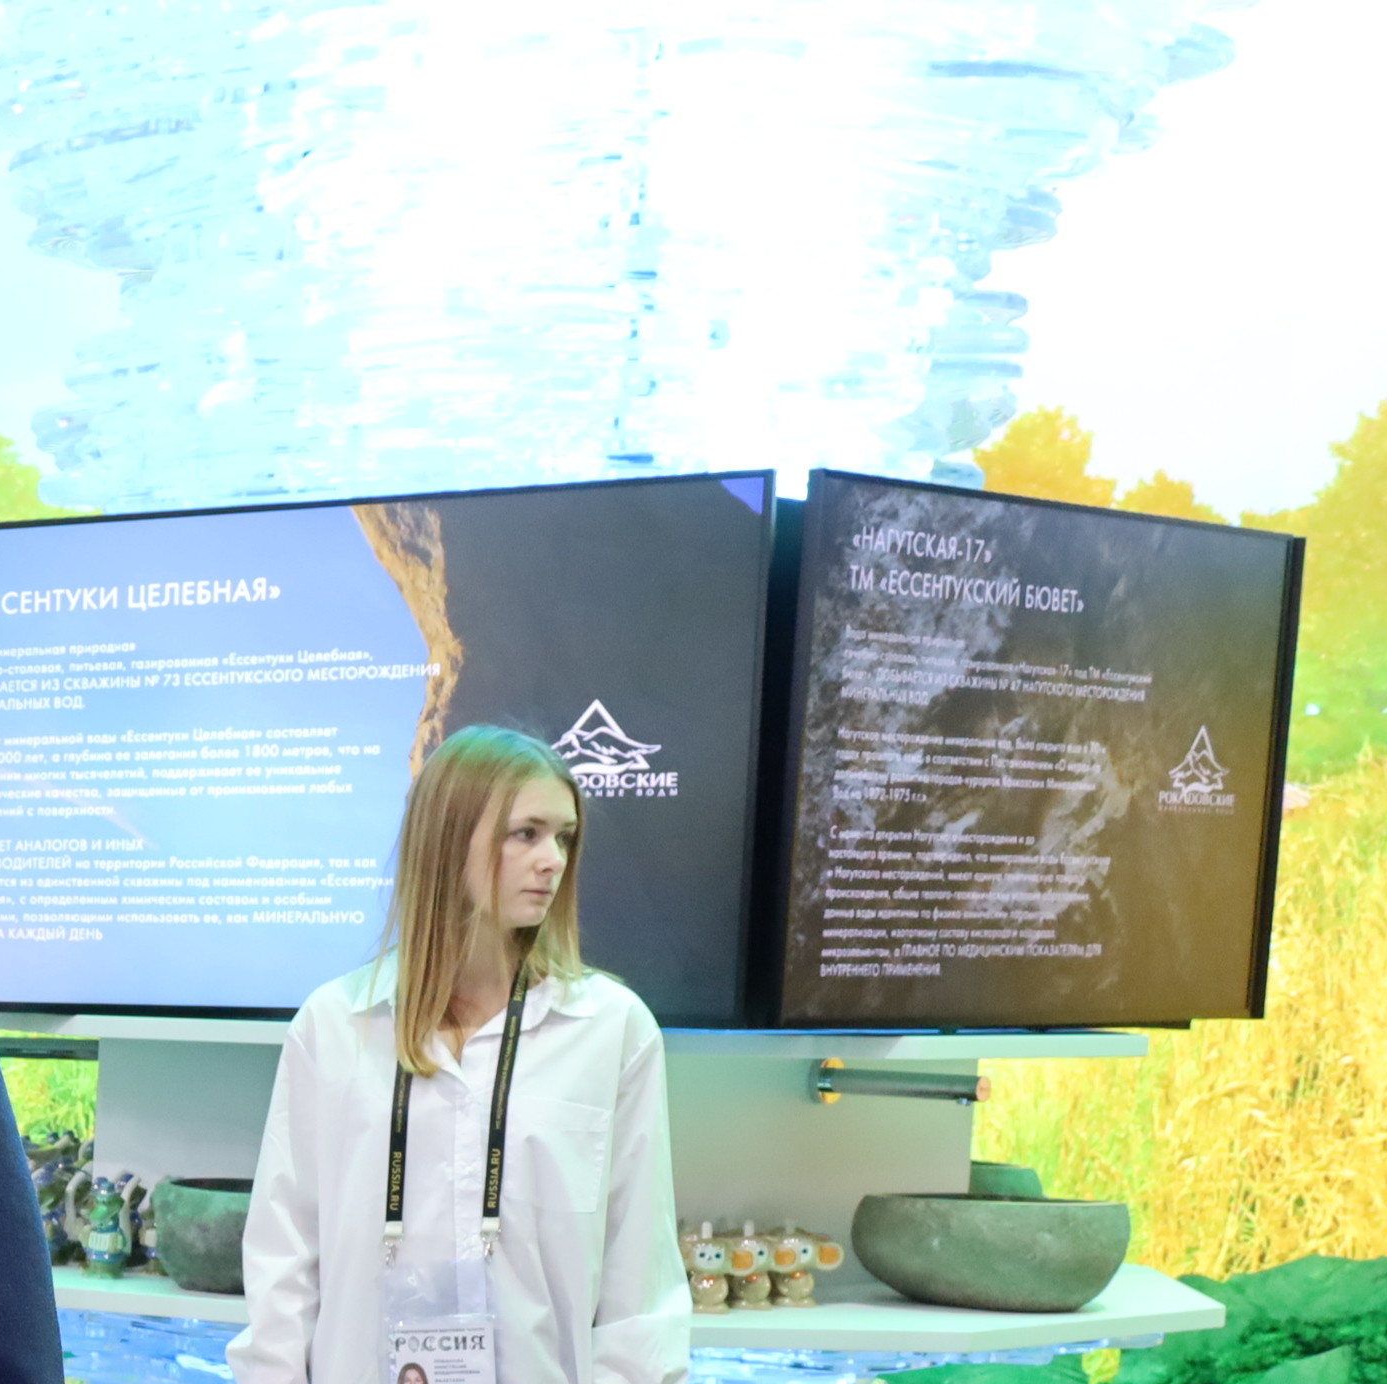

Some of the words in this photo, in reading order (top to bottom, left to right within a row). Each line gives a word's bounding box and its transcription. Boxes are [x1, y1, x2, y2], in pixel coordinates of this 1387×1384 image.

[853, 525, 992, 563] «НАГУТСКАЯ-17»
[128, 577, 281, 611] ЦЕЛЕБНАЯ»
[850, 565, 873, 590] ТМ
[880, 569, 1021, 607] «ЕССЕНТУКСКИЙ
[1025, 584, 1085, 612] БЮВЕТ»
[69, 642, 136, 656] природная
[131, 656, 218, 671] газированная
[222, 653, 294, 667] «Ессентуки
[297, 649, 373, 663] Целебная»,
[41, 678, 60, 691] ИЗ
[64, 675, 140, 691] СКВАЖИНЫ
[145, 675, 159, 687] №
[163, 674, 180, 687] 73
[184, 667, 303, 686] ЕССЕНТУКСКОГО
[307, 663, 441, 681] МЕСТОРОЖДЕНИЯ
[54, 696, 85, 710] ВОД.
[4, 733, 83, 747] минеральной
[87, 733, 116, 744] воды
[121, 730, 188, 744] «Ессентуки
[193, 727, 262, 742] Целебная»
[266, 727, 338, 738] составляет
[25, 754, 47, 764] лет,
[52, 754, 60, 762] а
[64, 750, 111, 765] глубина
[116, 752, 130, 761] ее
[134, 749, 197, 762] залегания
[201, 746, 239, 759] более
[245, 744, 279, 758] 1800
[282, 746, 333, 759] метров,
[338, 745, 360, 755] что
[364, 744, 380, 755] на
[25, 770, 66, 780] многих
[70, 767, 147, 780] тысячелетий,
[153, 765, 242, 780] поддерживает
[246, 766, 261, 776] ее
[265, 763, 342, 778] уникальные
[107, 785, 186, 798] защищенные
[190, 786, 204, 796] от
[207, 783, 305, 798] проникновения
[309, 781, 353, 794] любых
[27, 807, 34, 816] с
[37, 806, 116, 819] поверхности.
[15, 839, 87, 851] АНАЛОГОВ
[92, 840, 102, 850] И
[106, 839, 144, 850] ИНЫХ
[76, 859, 90, 869] на
[94, 859, 165, 872] территории
[170, 855, 242, 869] Российской
[329, 856, 349, 868] так
[355, 856, 377, 868] как
[20, 877, 34, 887] из
[37, 876, 120, 888] единственной
[123, 876, 182, 887] скважины
[187, 876, 209, 887] под
[213, 877, 316, 887] наименованием
[20, 896, 27, 905] с
[30, 895, 117, 907] определенным
[121, 895, 195, 905] химическим
[199, 896, 258, 905] составом
[262, 896, 269, 904] и
[274, 892, 331, 904] особыми
[23, 913, 113, 924] позволяющими
[117, 912, 199, 923] использовать
[227, 912, 248, 923] как
[253, 910, 365, 924] МИНЕРАЛЬНУЮ
[9, 927, 65, 941] КАЖДЫЙ
[69, 927, 103, 941] ДЕНЬ
[389, 1151, 402, 1211] RUSSIA.RU
[487, 1149, 501, 1209] RUSSIA.RU
[395, 1335, 486, 1353] РОССИЯ
